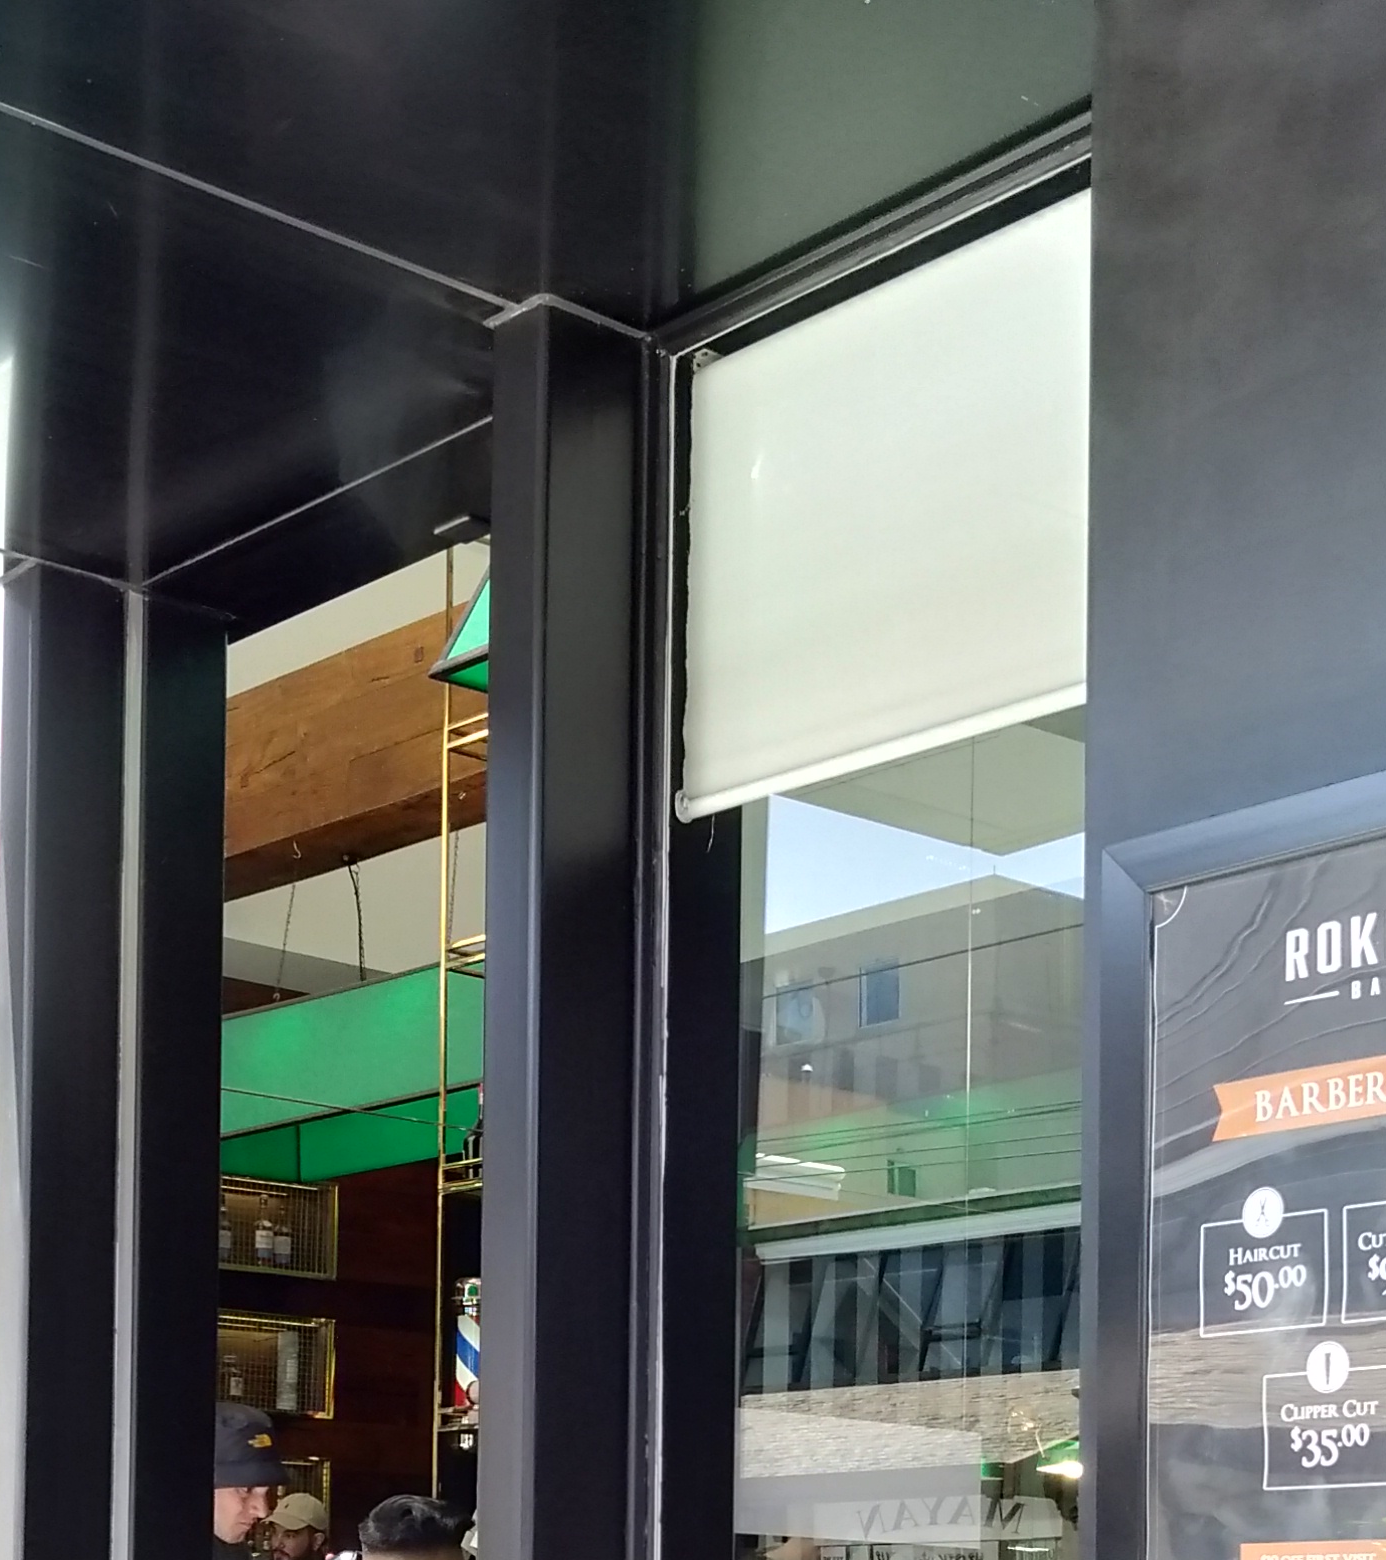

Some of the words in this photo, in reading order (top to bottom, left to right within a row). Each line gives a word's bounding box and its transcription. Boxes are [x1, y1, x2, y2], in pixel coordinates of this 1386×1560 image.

[1228, 1243, 1302, 1266] HAIRCUT
[1224, 1264, 1307, 1311] $50.00
[1280, 1403, 1339, 1422] CLIPPER
[1342, 1399, 1379, 1418] CUT
[1290, 1423, 1370, 1468] $35.00
